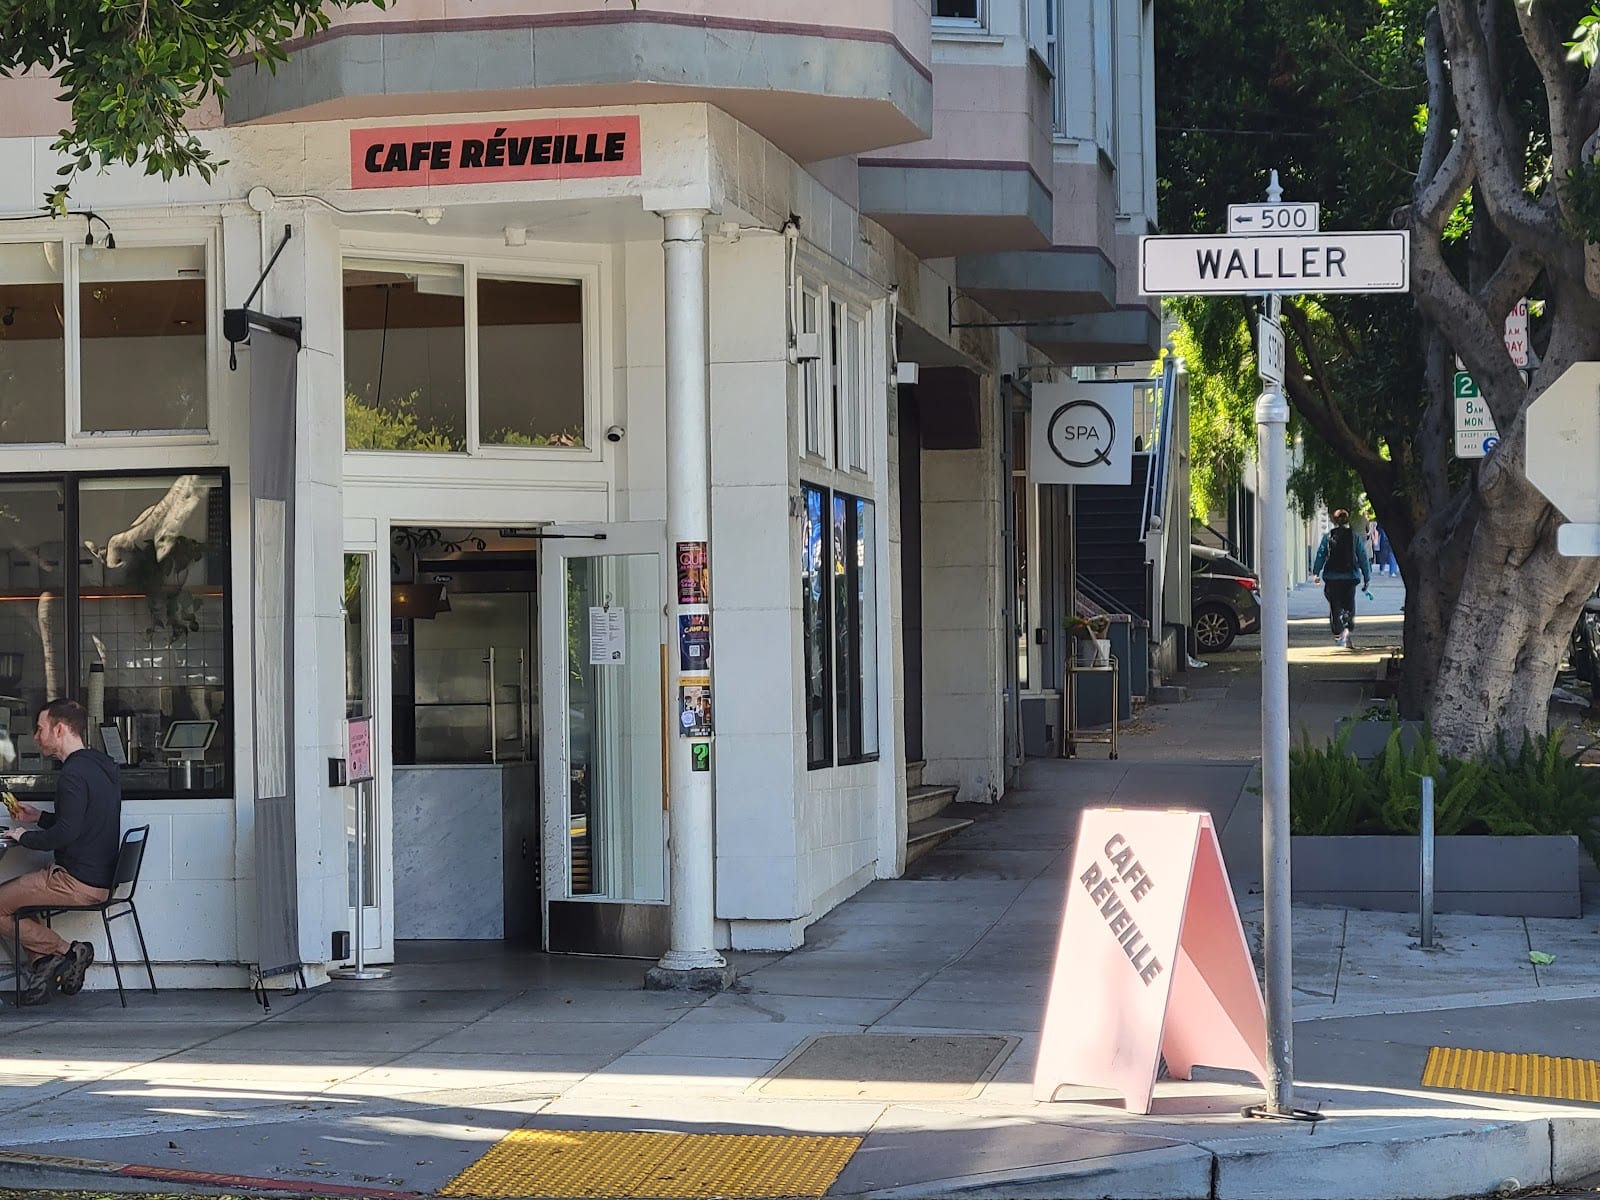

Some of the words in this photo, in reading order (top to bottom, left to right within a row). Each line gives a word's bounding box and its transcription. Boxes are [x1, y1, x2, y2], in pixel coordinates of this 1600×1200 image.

[365, 141, 452, 173] CAFE
[459, 128, 626, 168] RÉVEILLE
[1261, 209, 1307, 229] 500
[1196, 247, 1347, 279] WALLER
[1460, 377, 1473, 394] 2
[1064, 425, 1100, 441] SPA
[1464, 417, 1484, 427] MON
[1104, 832, 1154, 903] CAFE
[1079, 860, 1164, 987] RÉVEILLE
